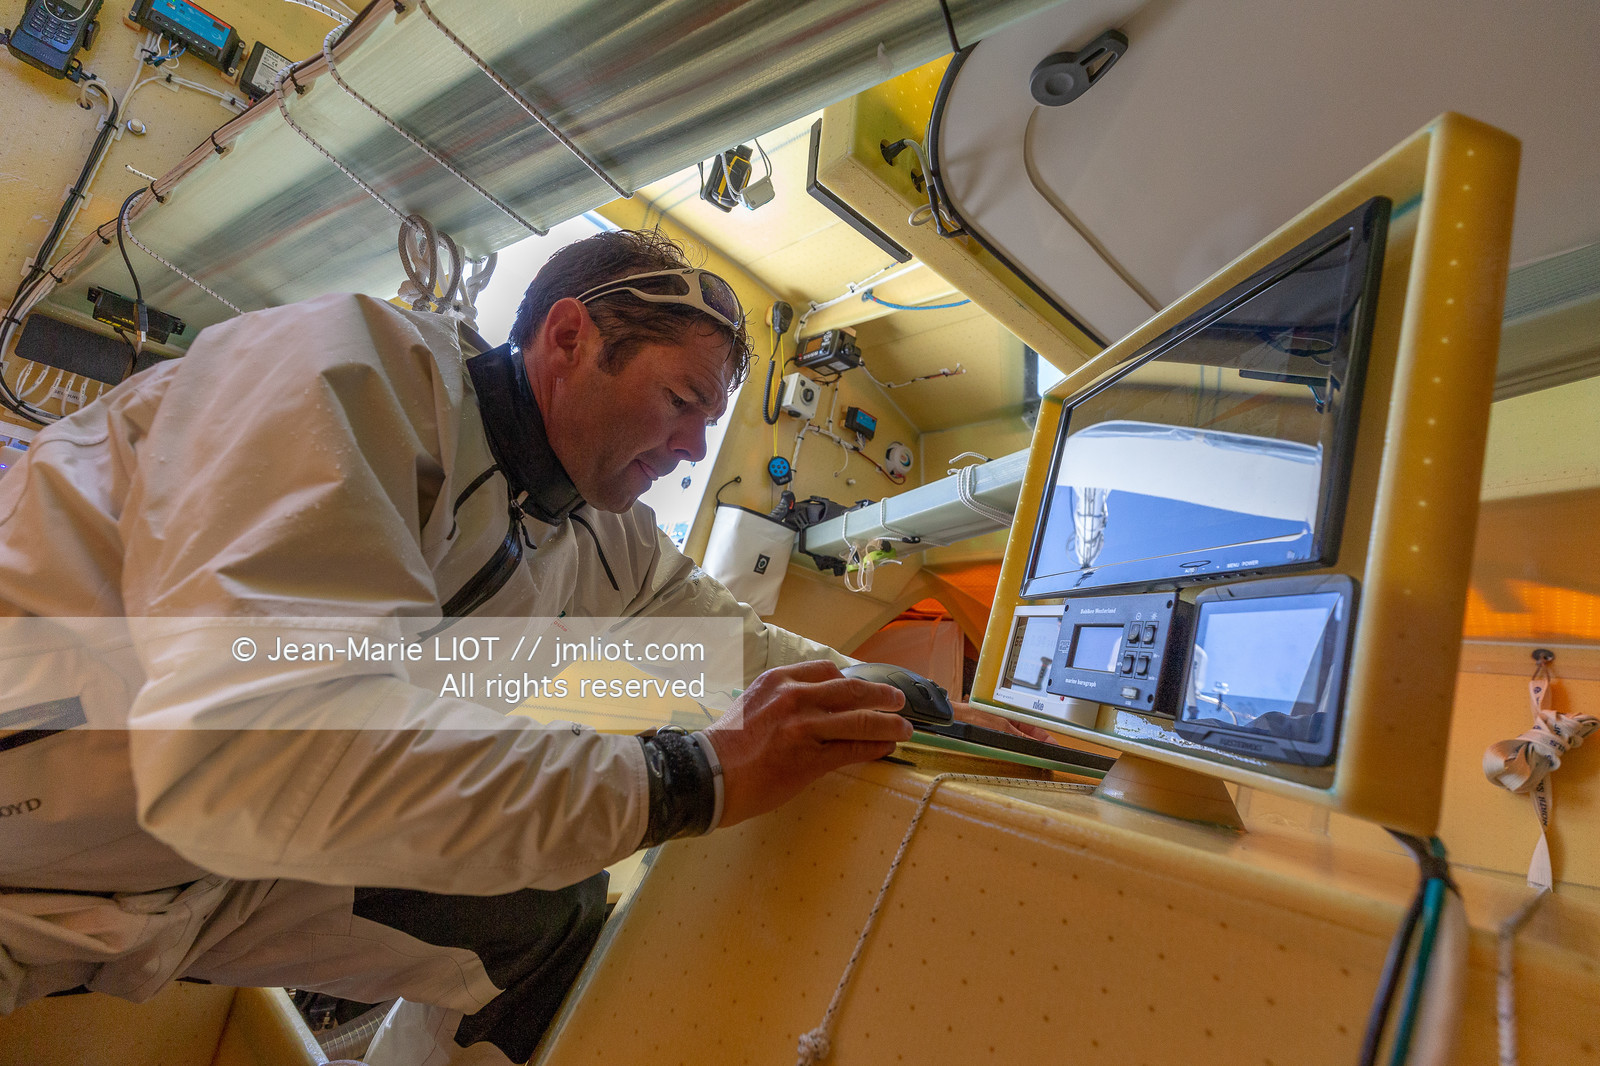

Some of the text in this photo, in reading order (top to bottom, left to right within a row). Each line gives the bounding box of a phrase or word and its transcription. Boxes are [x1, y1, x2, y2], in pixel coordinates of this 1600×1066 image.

[1241, 559, 1259, 567] POWER
[1032, 699, 1045, 711] nke
[1538, 795, 1548, 827] NORTH
